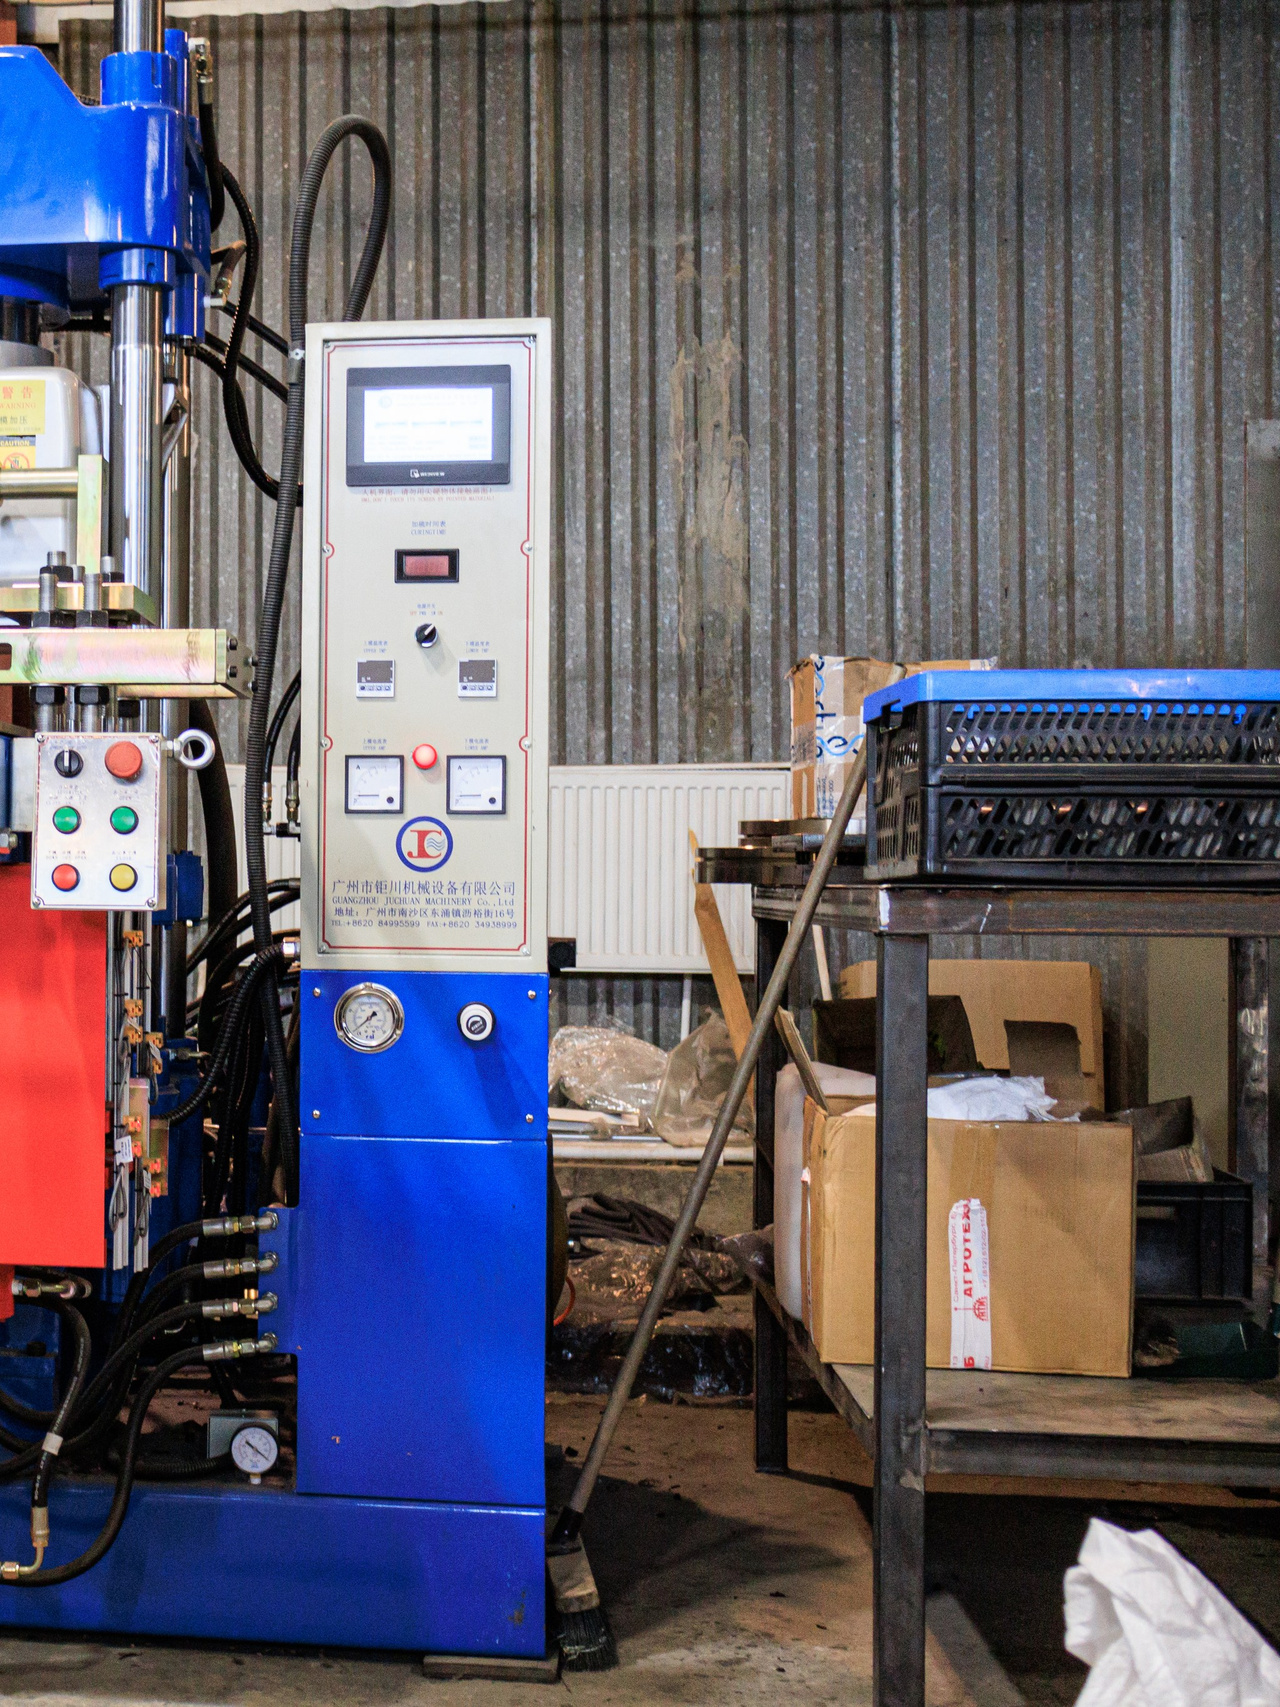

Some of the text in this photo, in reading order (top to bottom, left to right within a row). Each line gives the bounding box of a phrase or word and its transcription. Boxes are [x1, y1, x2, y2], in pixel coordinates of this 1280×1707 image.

[332, 896, 379, 905] GUANGZHOU
[384, 897, 420, 906] JUCHUAN
[425, 897, 472, 906] MACHINERY
